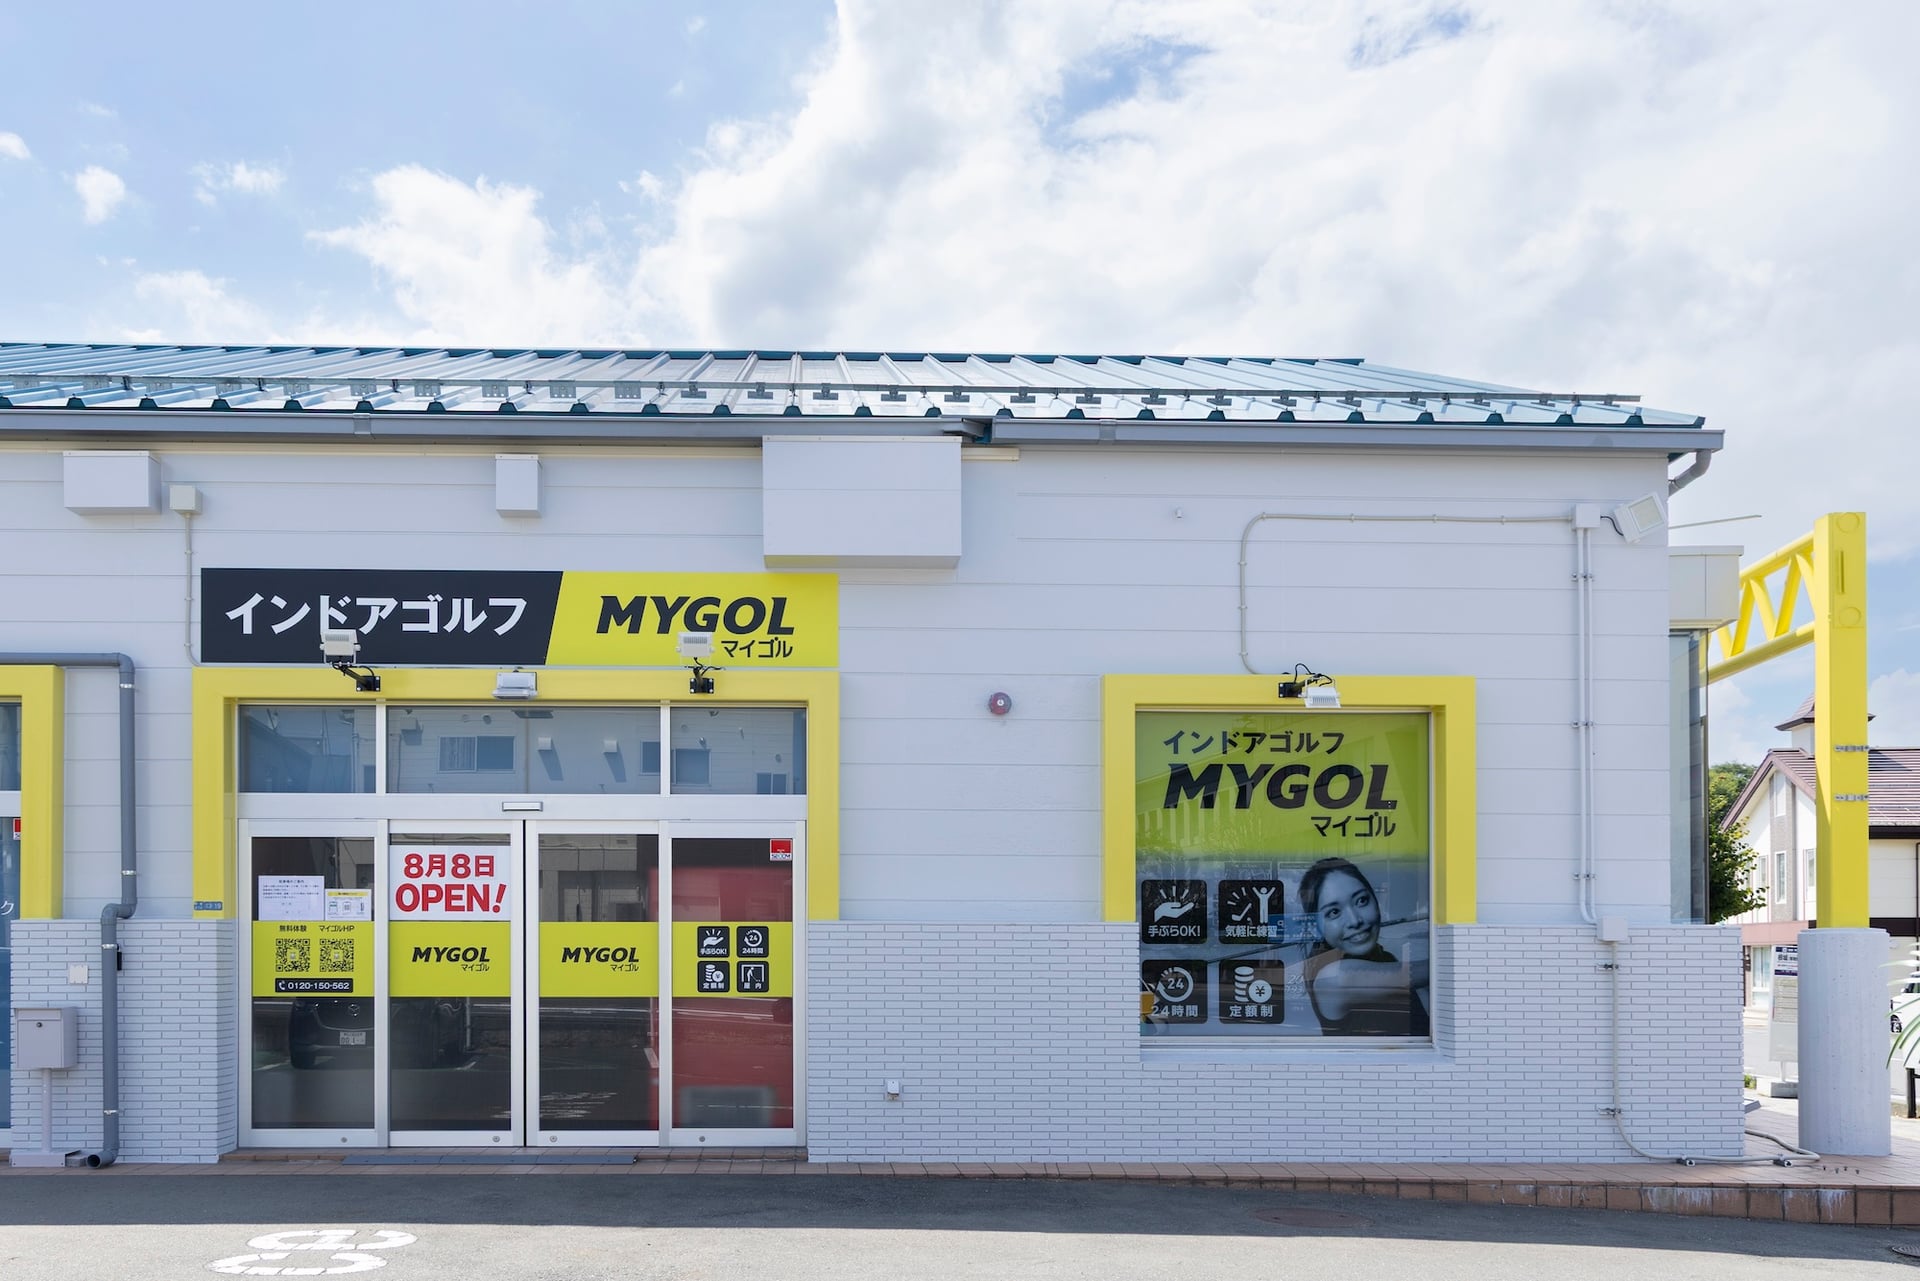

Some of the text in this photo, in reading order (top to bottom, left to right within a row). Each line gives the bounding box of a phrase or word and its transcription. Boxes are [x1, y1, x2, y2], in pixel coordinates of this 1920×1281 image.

[225, 592, 527, 636] インドアゴルフ
[596, 596, 795, 635] MYGOL
[720, 637, 793, 658] マイゴル
[1163, 730, 1345, 755] インドアゴルフ
[1163, 763, 1398, 810] MYGOL
[1310, 811, 1396, 838] マイゴル
[403, 853, 495, 879] 8月8日
[395, 883, 507, 913] OPEN!
[279, 924, 307, 933] 無料体験
[318, 924, 355, 933] マイゴルHP
[1147, 924, 1201, 938] 手ぶらOK!
[1224, 924, 1278, 938] 気軽に練習
[411, 946, 490, 963] MYGOL
[561, 946, 640, 963] MYGOL
[742, 946, 764, 954] 24時間
[461, 963, 490, 972] マイゴル
[610, 963, 640, 972] マイゴル
[287, 981, 350, 990] 0120-150-562
[1167, 977, 1185, 990] 24
[1150, 1004, 1199, 1018] 24時間
[1229, 1004, 1274, 1018] 定額制
